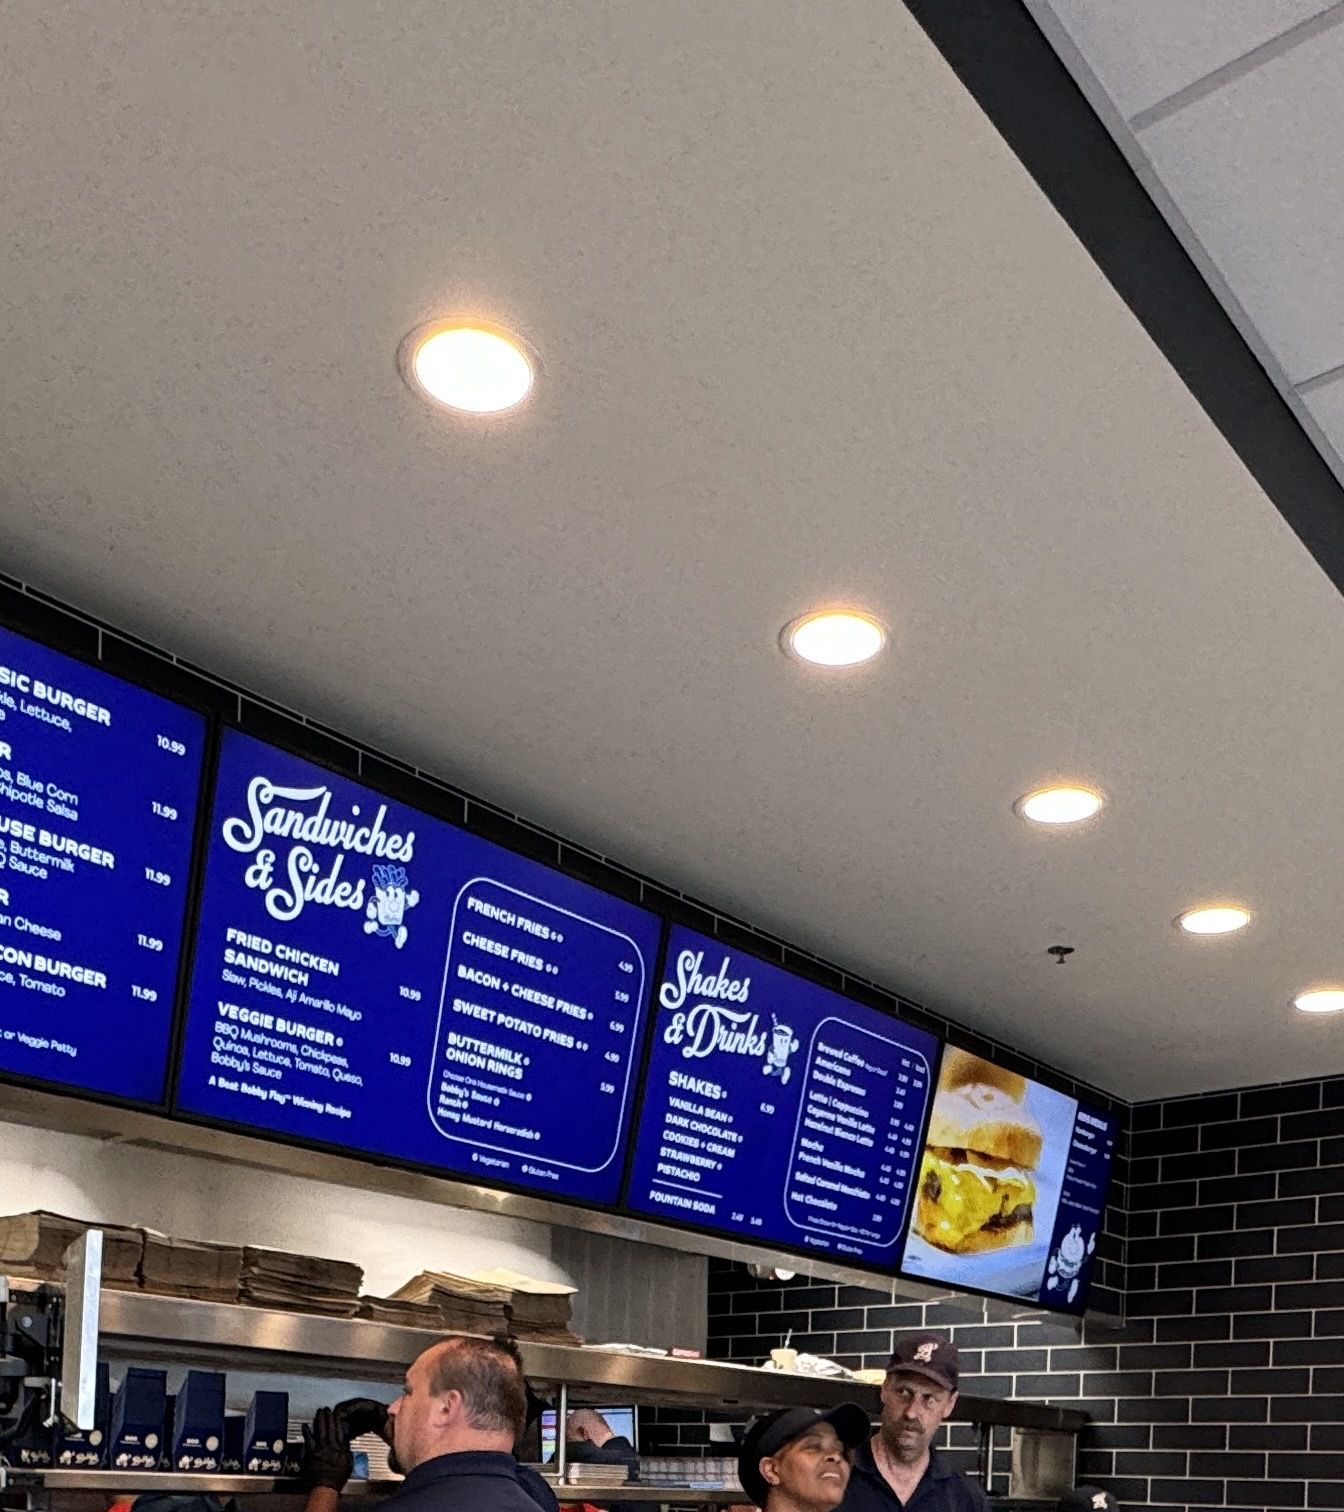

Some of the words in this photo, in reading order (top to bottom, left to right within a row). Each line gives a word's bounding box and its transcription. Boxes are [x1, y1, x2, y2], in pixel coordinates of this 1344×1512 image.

[19, 699, 72, 733] Lettuce,
[32, 680, 111, 727] BURGER
[16, 771, 44, 794] Blue
[151, 801, 178, 821] 11.99
[223, 777, 415, 862] Sandwiches
[38, 829, 115, 869] BURGER
[8, 855, 48, 880] Sauce
[144, 867, 171, 886] 11.99
[245, 849, 276, 890] &
[265, 846, 366, 921] Sides
[13, 915, 62, 942] Cheese
[466, 896, 516, 927] FRENCH
[516, 916, 550, 940] FRIES
[137, 933, 164, 952] 11.99
[226, 927, 273, 954] FRIED
[275, 944, 340, 976] CHICKEN
[462, 931, 510, 959] CHEESE
[510, 948, 544, 971] FRIES
[18, 972, 66, 998] Tomato
[33, 954, 107, 989] BURGER
[223, 948, 309, 987] SANDWICH
[659, 950, 751, 1010] Shakes
[131, 984, 158, 1002] 11.99
[248, 976, 284, 999] Pickles,
[336, 1003, 363, 1022] Mayo
[457, 964, 501, 990] BACON
[511, 983, 556, 1010] CHEESE
[555, 999, 587, 1020] FRIES
[217, 1001, 275, 1030] VEGGIE
[275, 1017, 335, 1047] BURGER
[452, 998, 497, 1023] SWEET
[496, 1013, 543, 1038] POTATO
[542, 1028, 575, 1049] FRIES
[664, 1013, 685, 1044] &
[682, 1003, 768, 1058] Drinks
[210, 1050, 251, 1073] Bobby's
[251, 1061, 283, 1080] Sauce
[445, 1047, 487, 1070] ONION
[486, 1058, 523, 1080] RINGS
[447, 1031, 523, 1066] BUTTERMILK
[668, 1070, 722, 1100] SHAKES
[649, 1190, 693, 1209] FOUNTAIN
[692, 1200, 716, 1215] SODA
